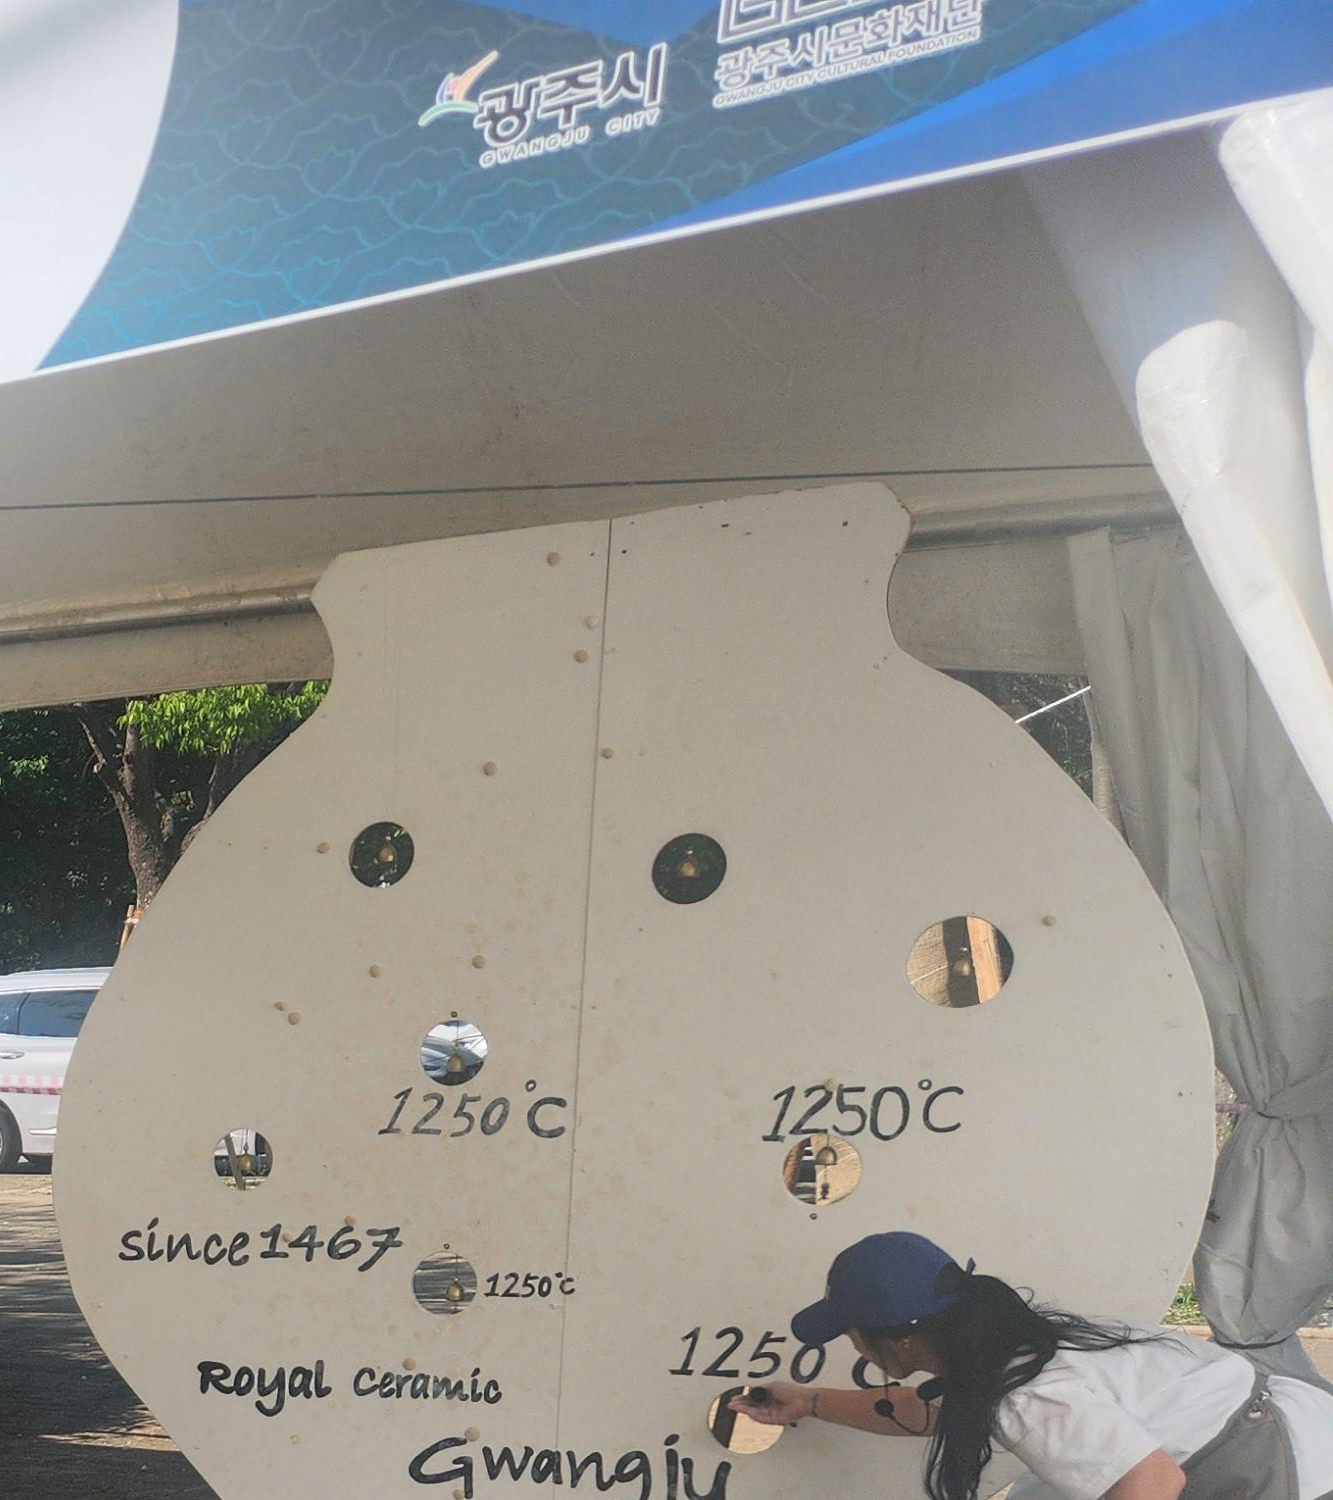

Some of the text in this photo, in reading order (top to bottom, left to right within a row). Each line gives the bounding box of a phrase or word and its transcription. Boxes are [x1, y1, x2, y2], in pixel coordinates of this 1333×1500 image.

[816, 56, 885, 85] CULTURAL
[886, 29, 979, 62] FOUNDATION
[473, 43, 666, 146] 광주시
[479, 107, 660, 168] GWANGJU CITY
[197, 1359, 332, 1417] Royal
